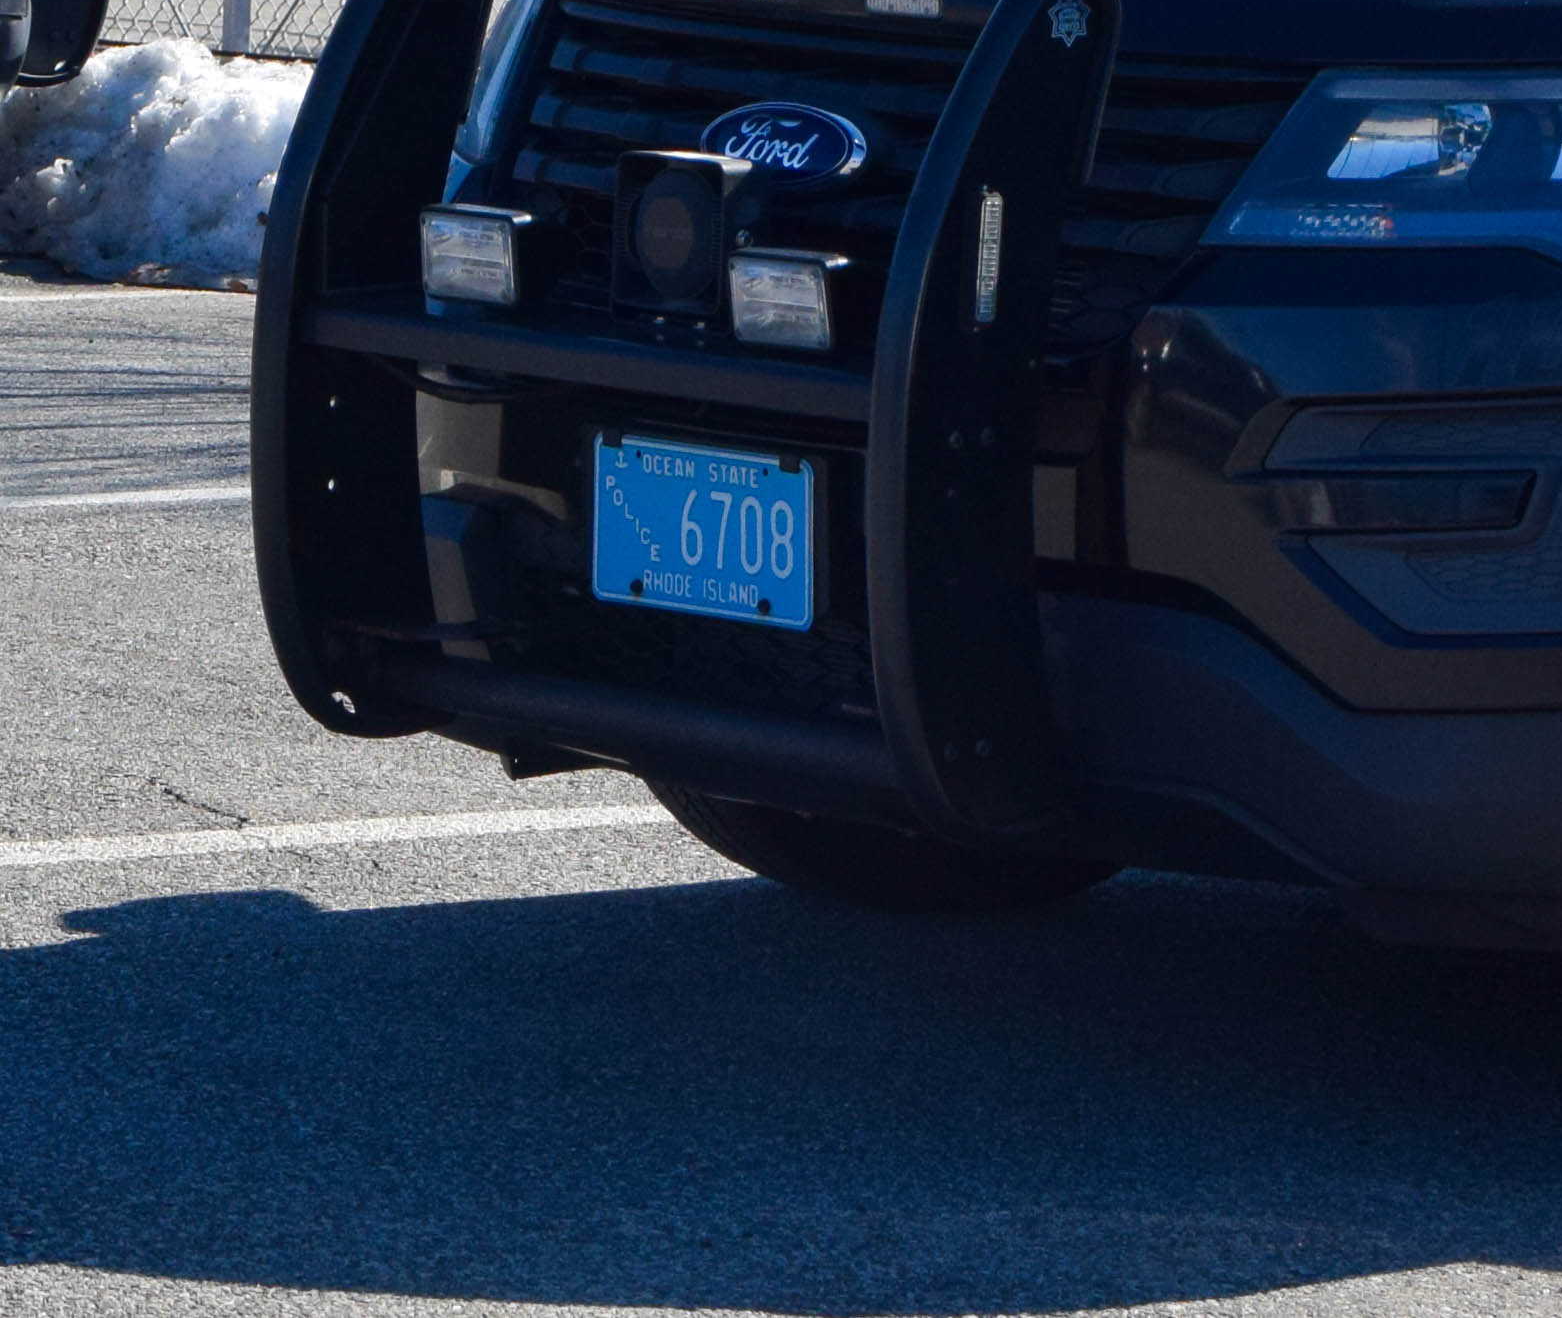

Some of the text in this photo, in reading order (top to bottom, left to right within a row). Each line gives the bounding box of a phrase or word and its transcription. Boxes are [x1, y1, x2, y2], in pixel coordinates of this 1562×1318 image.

[724, 114, 820, 169] Ford
[642, 453, 760, 489] OCEAN STATE
[605, 474, 662, 563] POLICE
[680, 488, 795, 580] 6708
[642, 569, 760, 609] RHODE ISLAND
